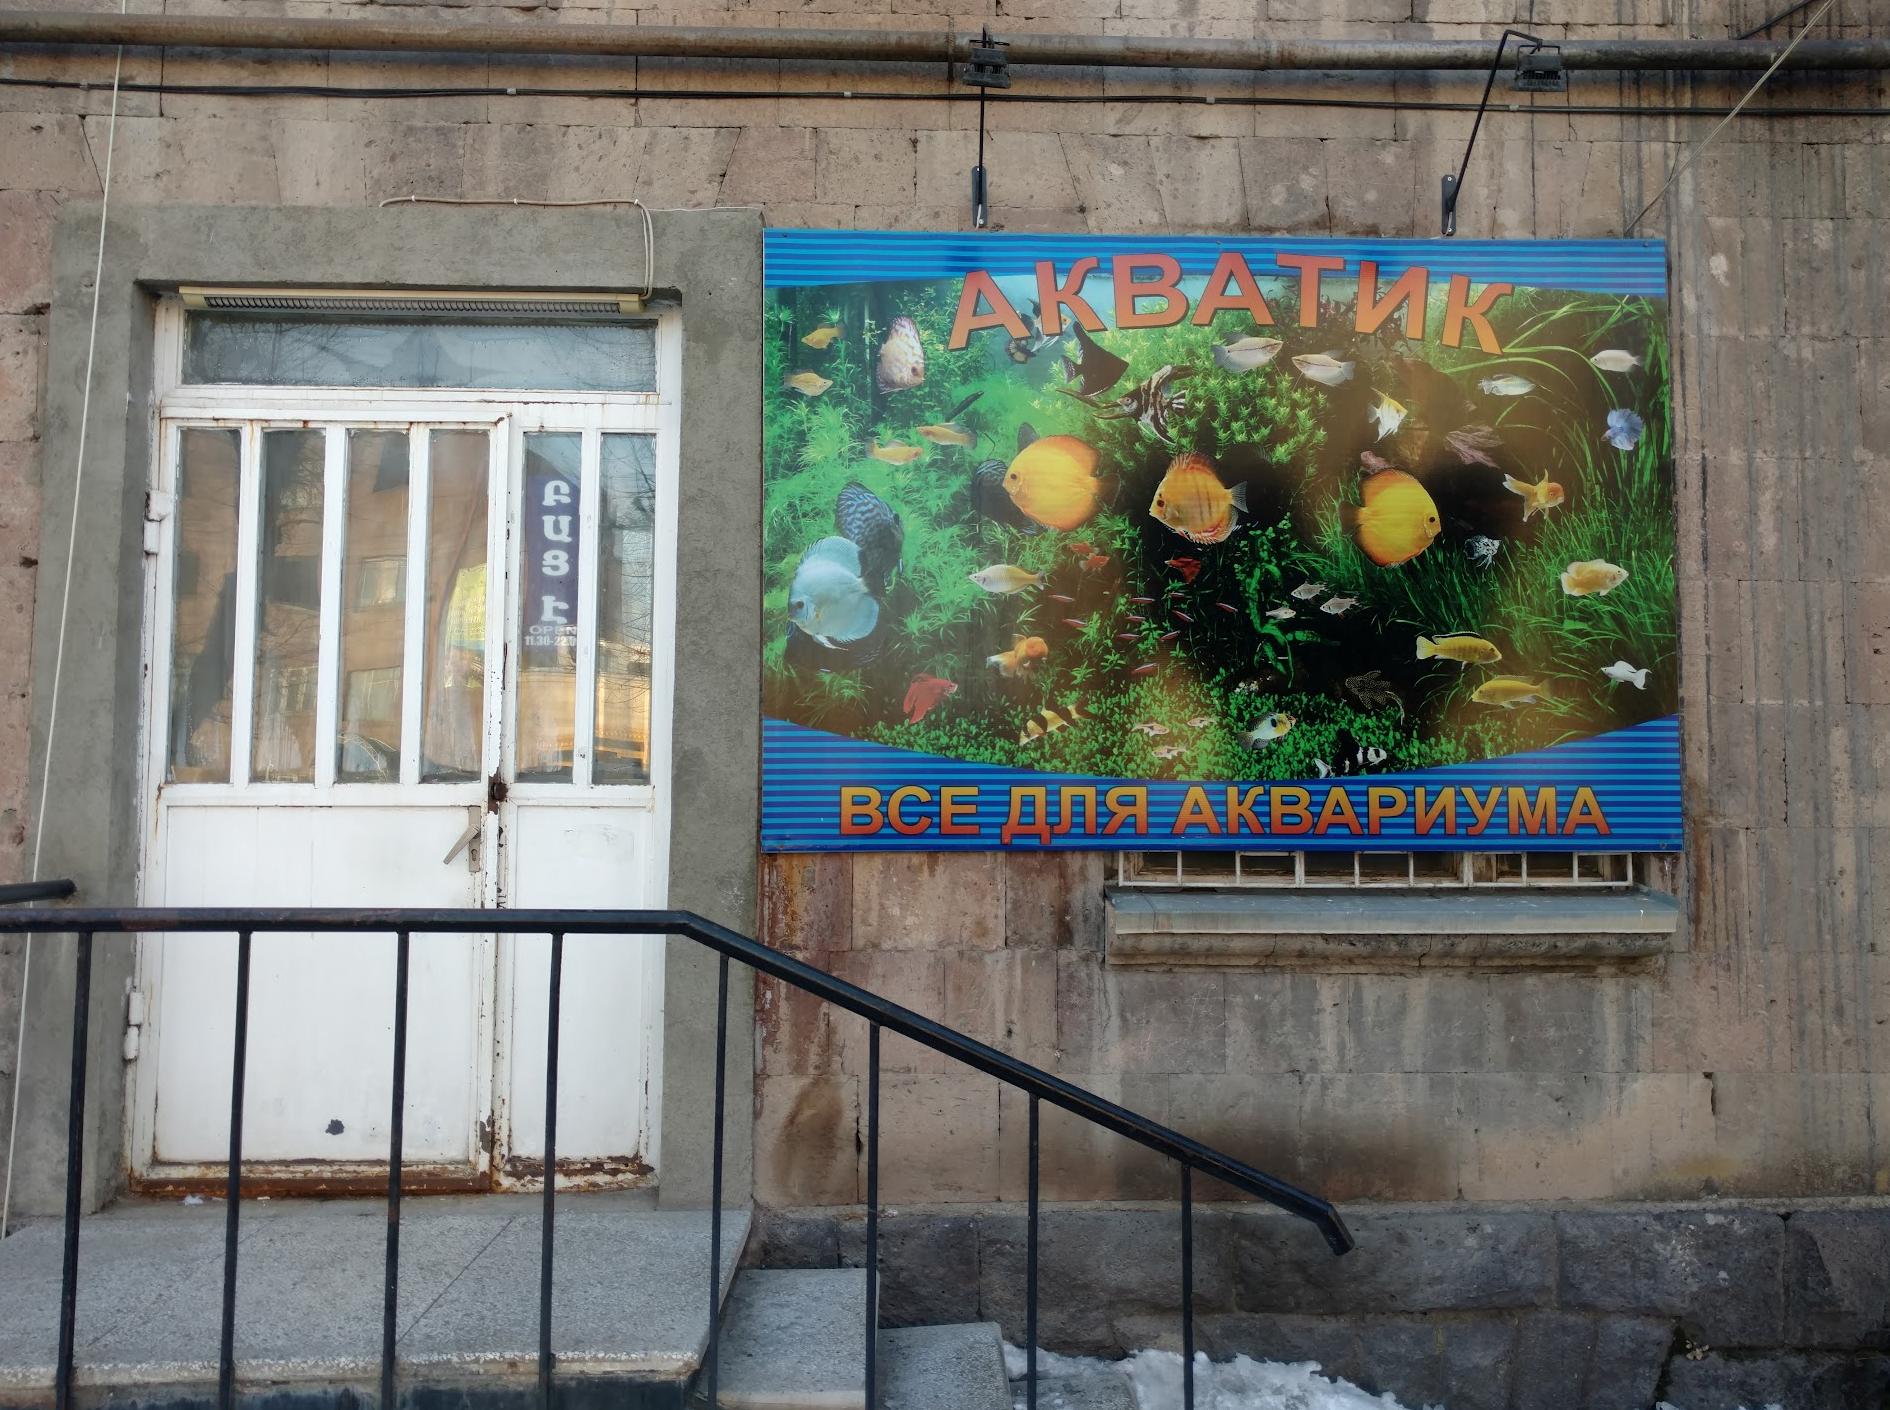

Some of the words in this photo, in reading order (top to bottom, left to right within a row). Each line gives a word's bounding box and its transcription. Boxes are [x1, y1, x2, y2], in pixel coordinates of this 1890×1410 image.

[947, 252, 1514, 355] АКВАТИК
[529, 625, 577, 635] OPEN
[839, 785, 980, 835] ВСЕ
[1001, 785, 1148, 845] ДЛЯ
[1172, 785, 1612, 835] АКВАРИУМА
